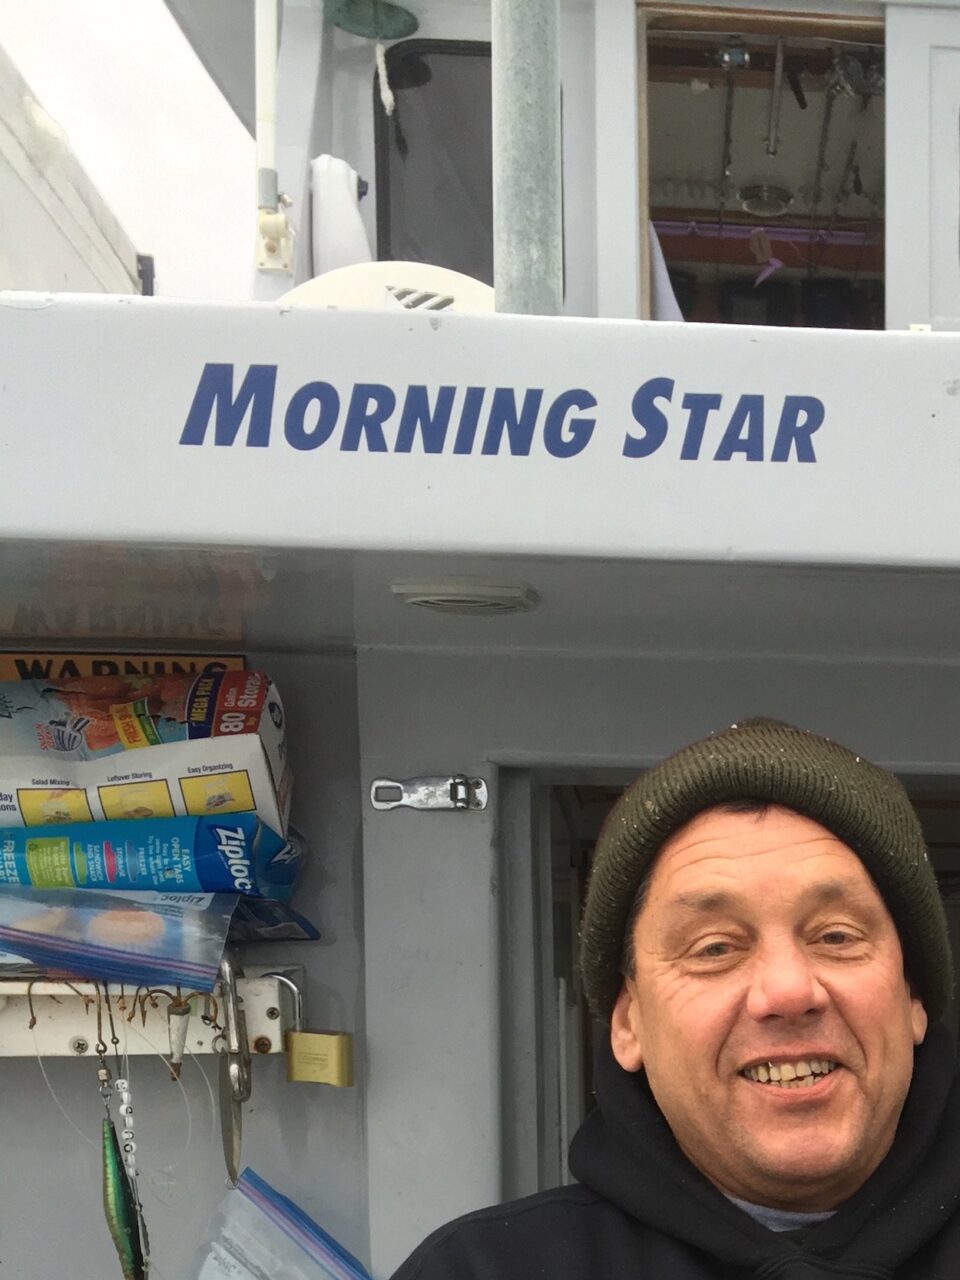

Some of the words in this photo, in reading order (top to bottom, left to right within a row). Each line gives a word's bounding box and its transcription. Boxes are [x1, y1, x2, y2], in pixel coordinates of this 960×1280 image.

[179, 363, 598, 459] MORNING
[623, 376, 826, 464] STAR
[220, 712, 247, 733] 80
[2, 839, 20, 884] FREEZE
[171, 836, 180, 861] OPEN
[181, 848, 192, 872] EASY
[215, 826, 252, 890] Ziploc
